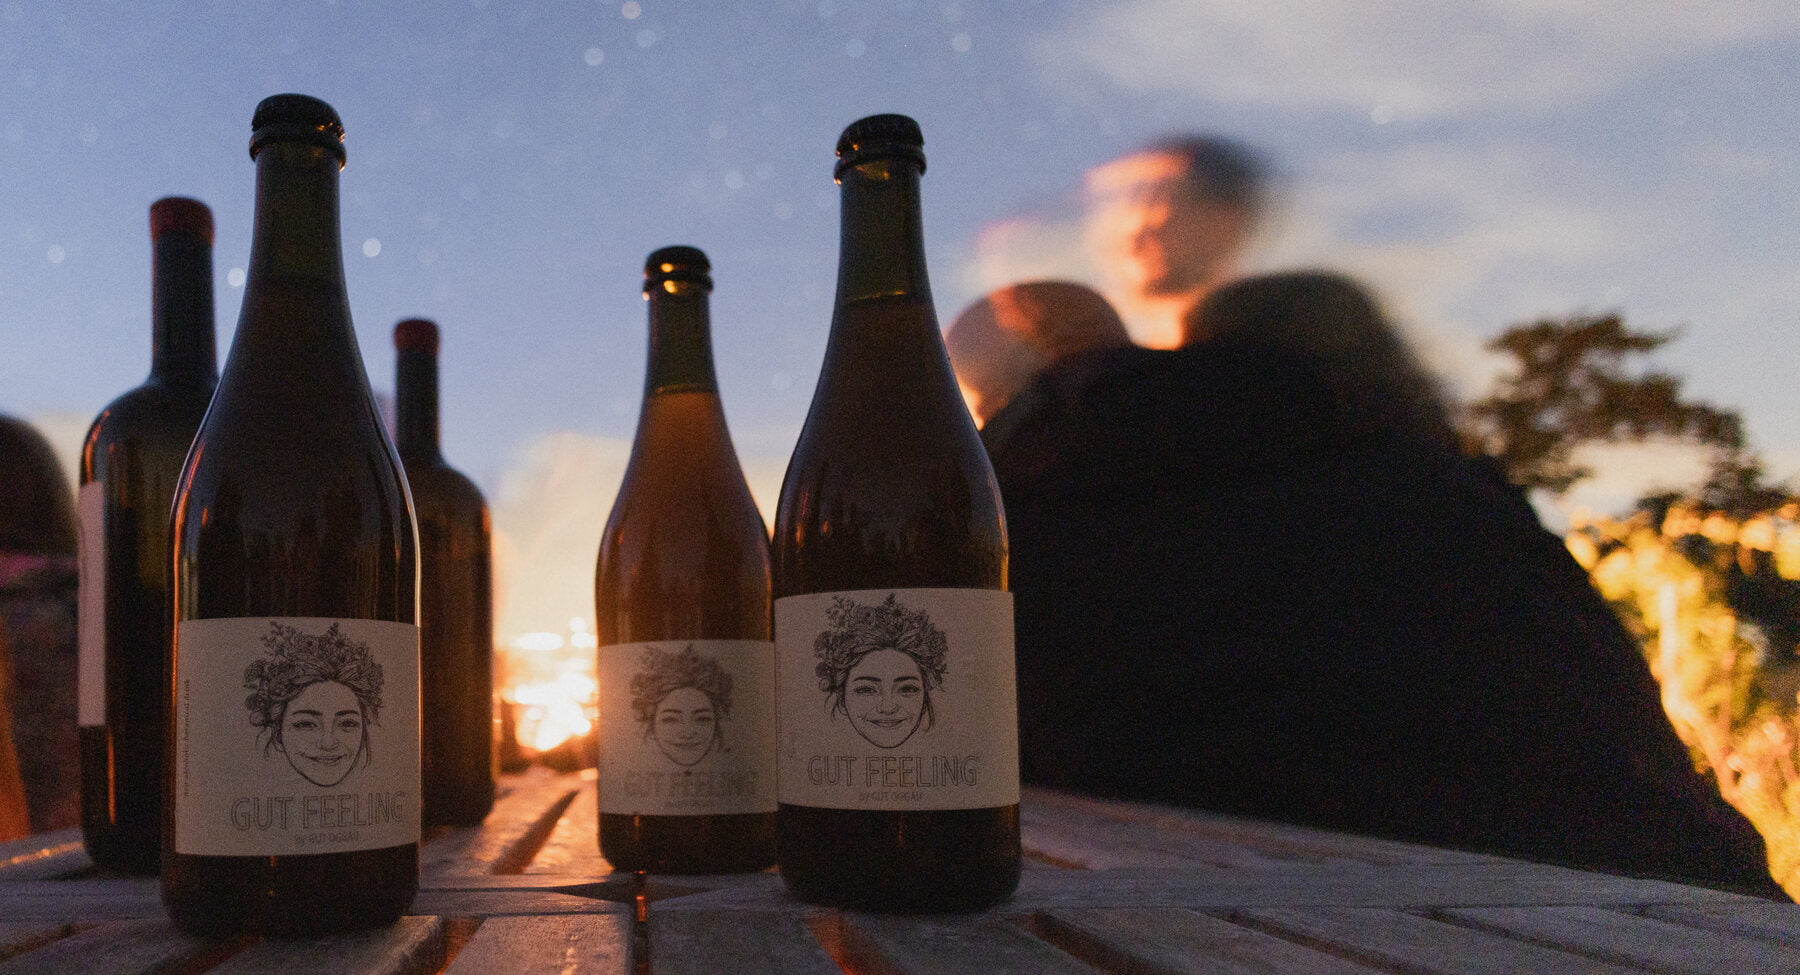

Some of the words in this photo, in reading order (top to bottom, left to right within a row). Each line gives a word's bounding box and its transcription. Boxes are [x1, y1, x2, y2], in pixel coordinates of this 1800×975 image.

[624, 771, 665, 798] GUT
[808, 755, 857, 787] GUT
[865, 755, 978, 788] FEELING
[230, 796, 293, 831] GUT
[302, 791, 405, 830] FEELING
